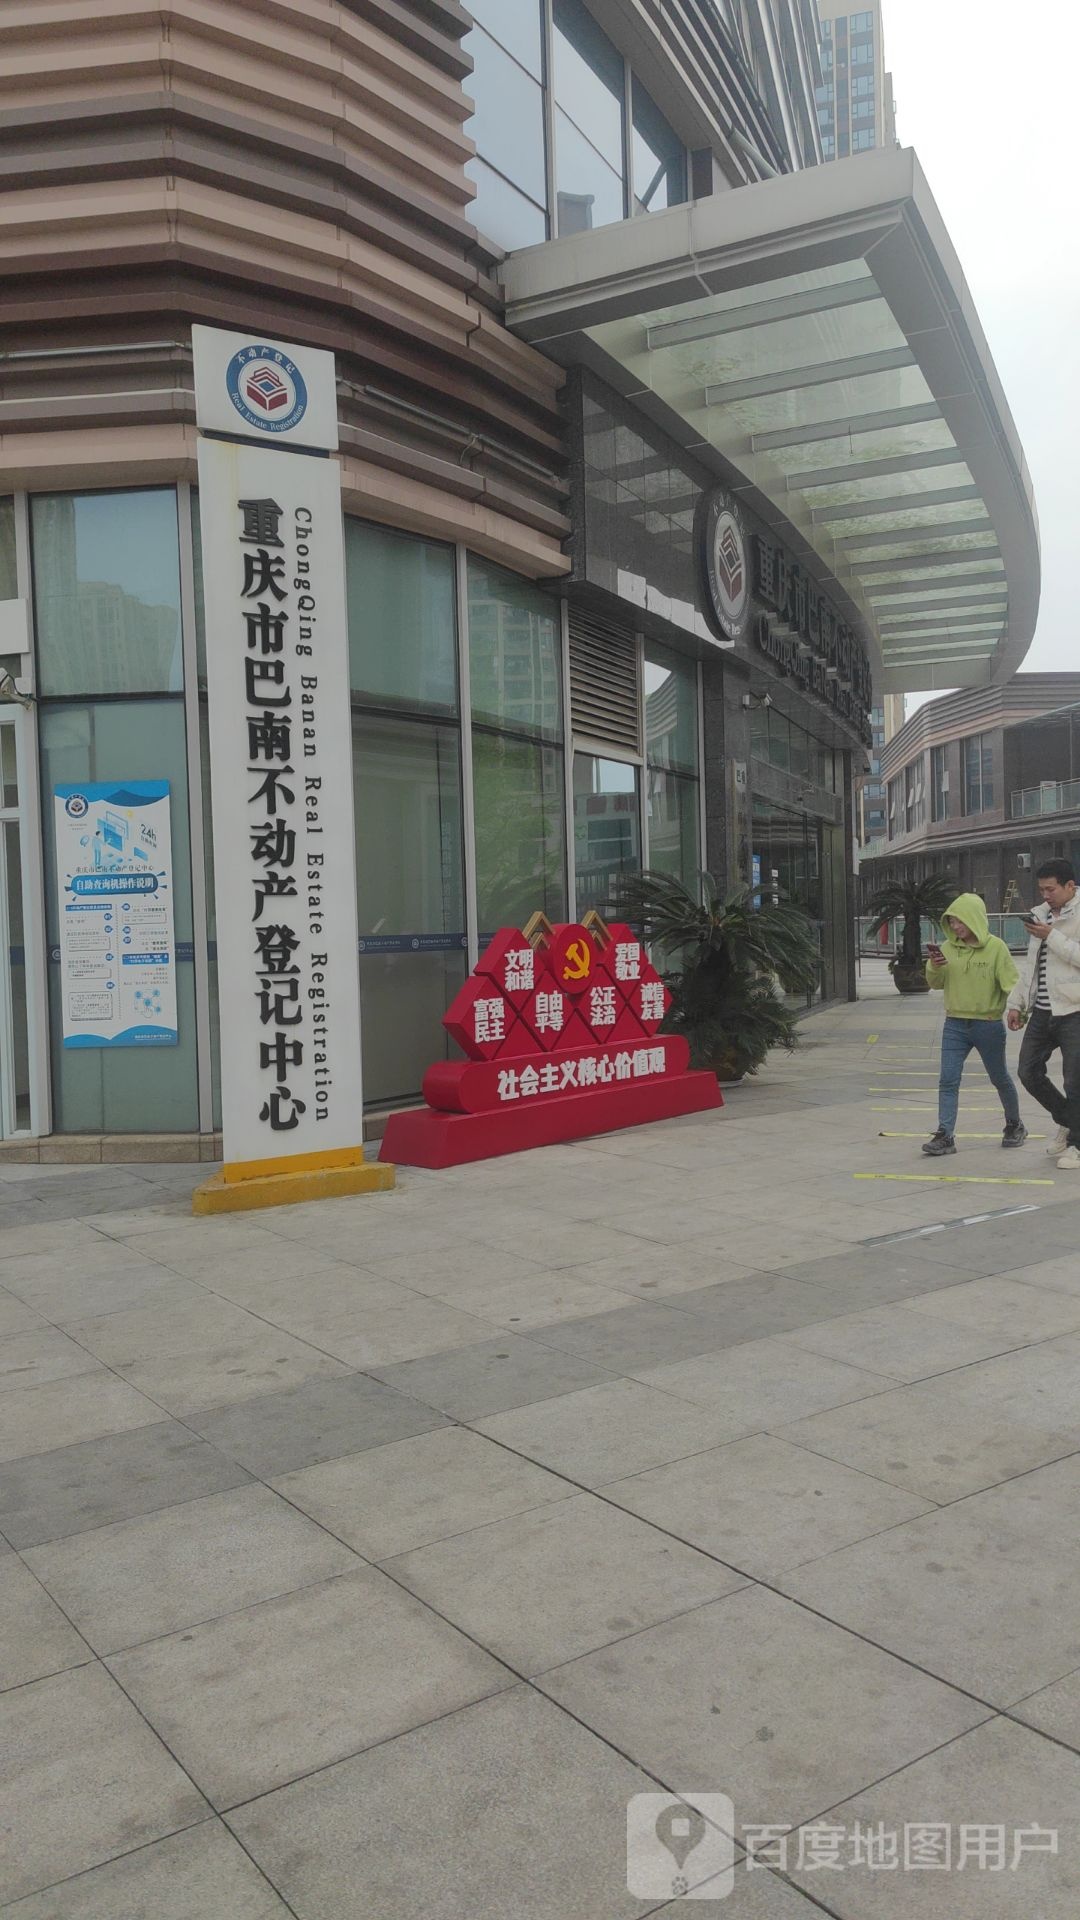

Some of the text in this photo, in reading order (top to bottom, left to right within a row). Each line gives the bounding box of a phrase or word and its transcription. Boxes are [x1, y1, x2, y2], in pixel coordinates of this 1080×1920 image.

[236, 347, 294, 373] 不动产登记
[231, 391, 304, 432] Real Estate Registration
[237, 497, 307, 1132] 重庆市巴南不动产登记中心
[293, 505, 330, 1122] ChongQing Banan Real Estate Registration
[140, 823, 157, 842] 24h
[76, 877, 154, 891] 自助查询机操作说明
[504, 948, 534, 971] 文明
[615, 942, 640, 962] 爱国
[504, 969, 535, 992] 和谐
[615, 960, 641, 981] 敬业
[535, 990, 564, 1013] 自由
[590, 985, 616, 1006] 公正
[640, 981, 665, 1002] 诚信
[473, 997, 505, 1021] 富强
[590, 1006, 616, 1027] 法治
[640, 1000, 665, 1021] 友善
[474, 1019, 506, 1044] 民主
[535, 1011, 564, 1034] 平等
[496, 1046, 667, 1101] 社会主义核心价值观
